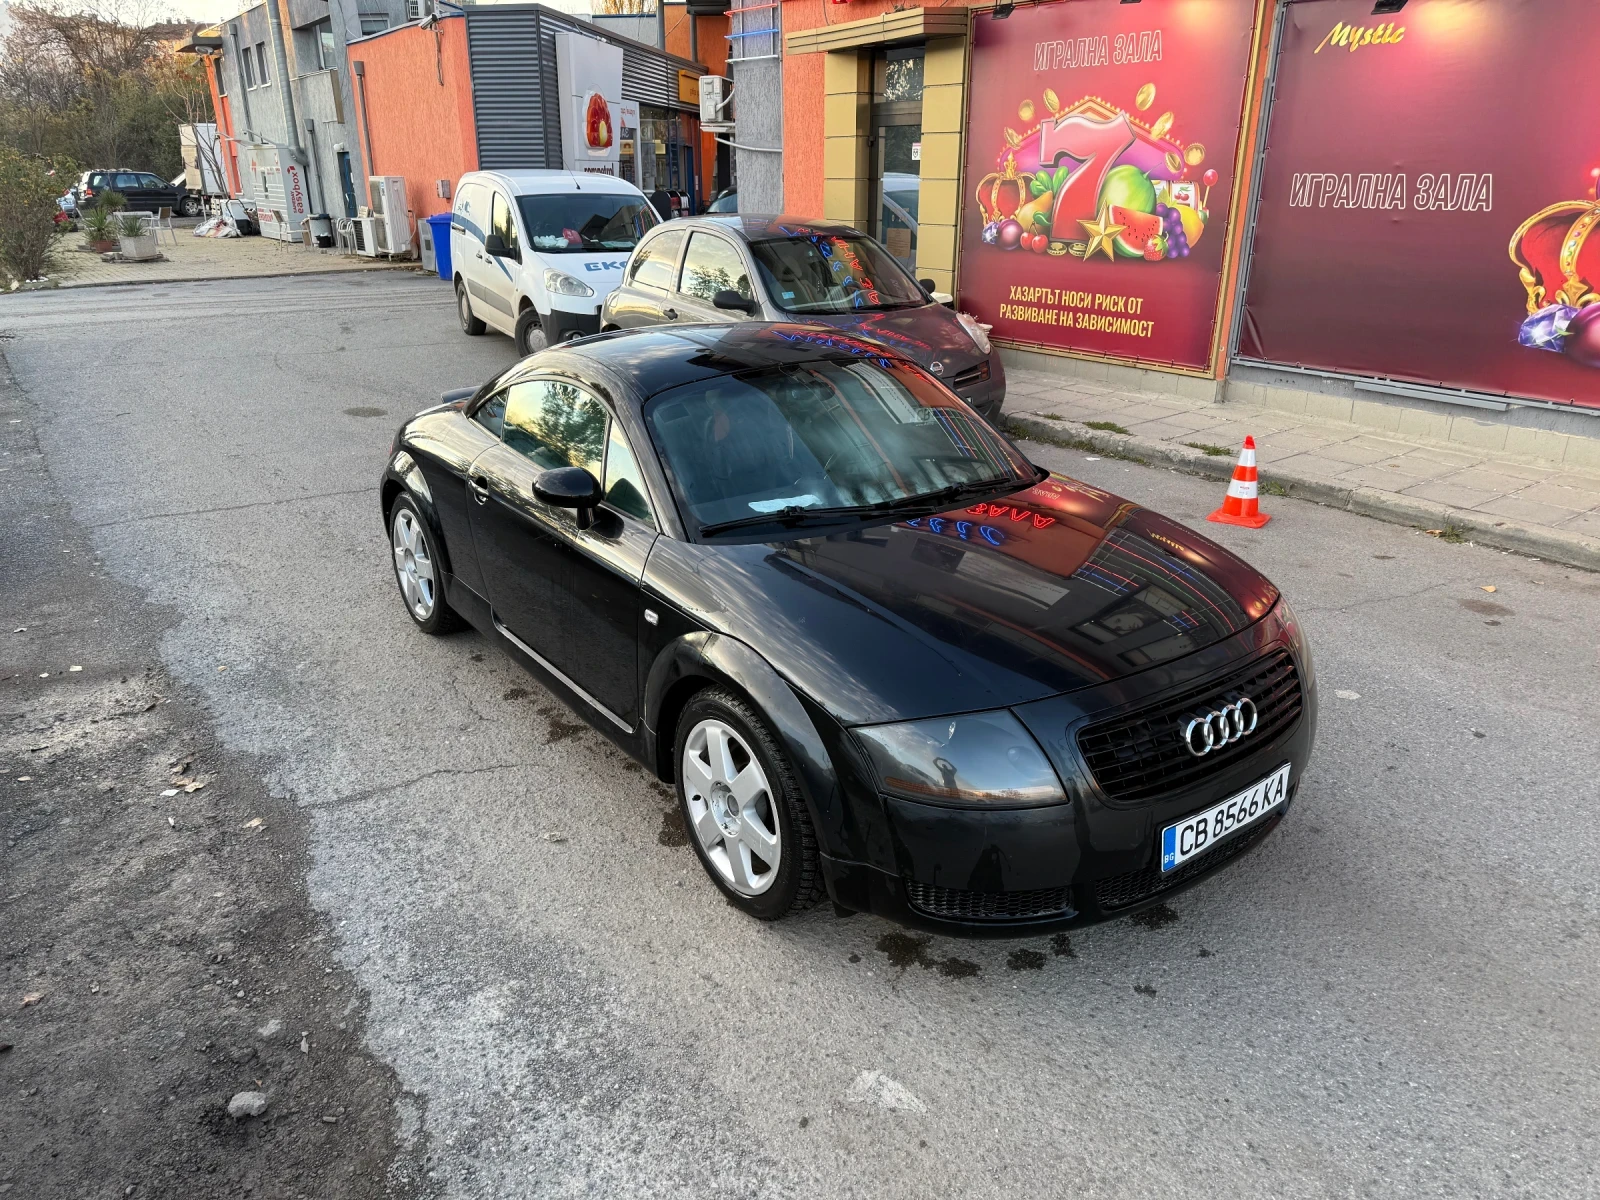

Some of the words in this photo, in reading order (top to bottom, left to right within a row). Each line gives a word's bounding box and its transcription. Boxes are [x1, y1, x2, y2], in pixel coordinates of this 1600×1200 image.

[1034, 35, 1108, 71] ИГРАЛНА
[1113, 30, 1163, 65] ЗАЛА
[1314, 21, 1407, 54] Mystic
[292, 172, 304, 214] easybox
[1289, 173, 1406, 209] ИГРАЛНА
[1413, 174, 1493, 211] ЗАЛА
[1009, 285, 1060, 306] ХАЗАРТЪТ
[1061, 291, 1092, 309] НОСИ
[1095, 294, 1126, 313] РИСК
[1128, 298, 1144, 315] ОТ
[999, 304, 1057, 326] РАЗВИВАНЕ
[1059, 310, 1074, 328] НА
[1076, 312, 1155, 338] ЗАВИСИМОСТ
[1180, 818, 1208, 856] CB
[1213, 789, 1259, 838] 8566
[1261, 773, 1284, 810] KA
[1164, 853, 1175, 863] BG
